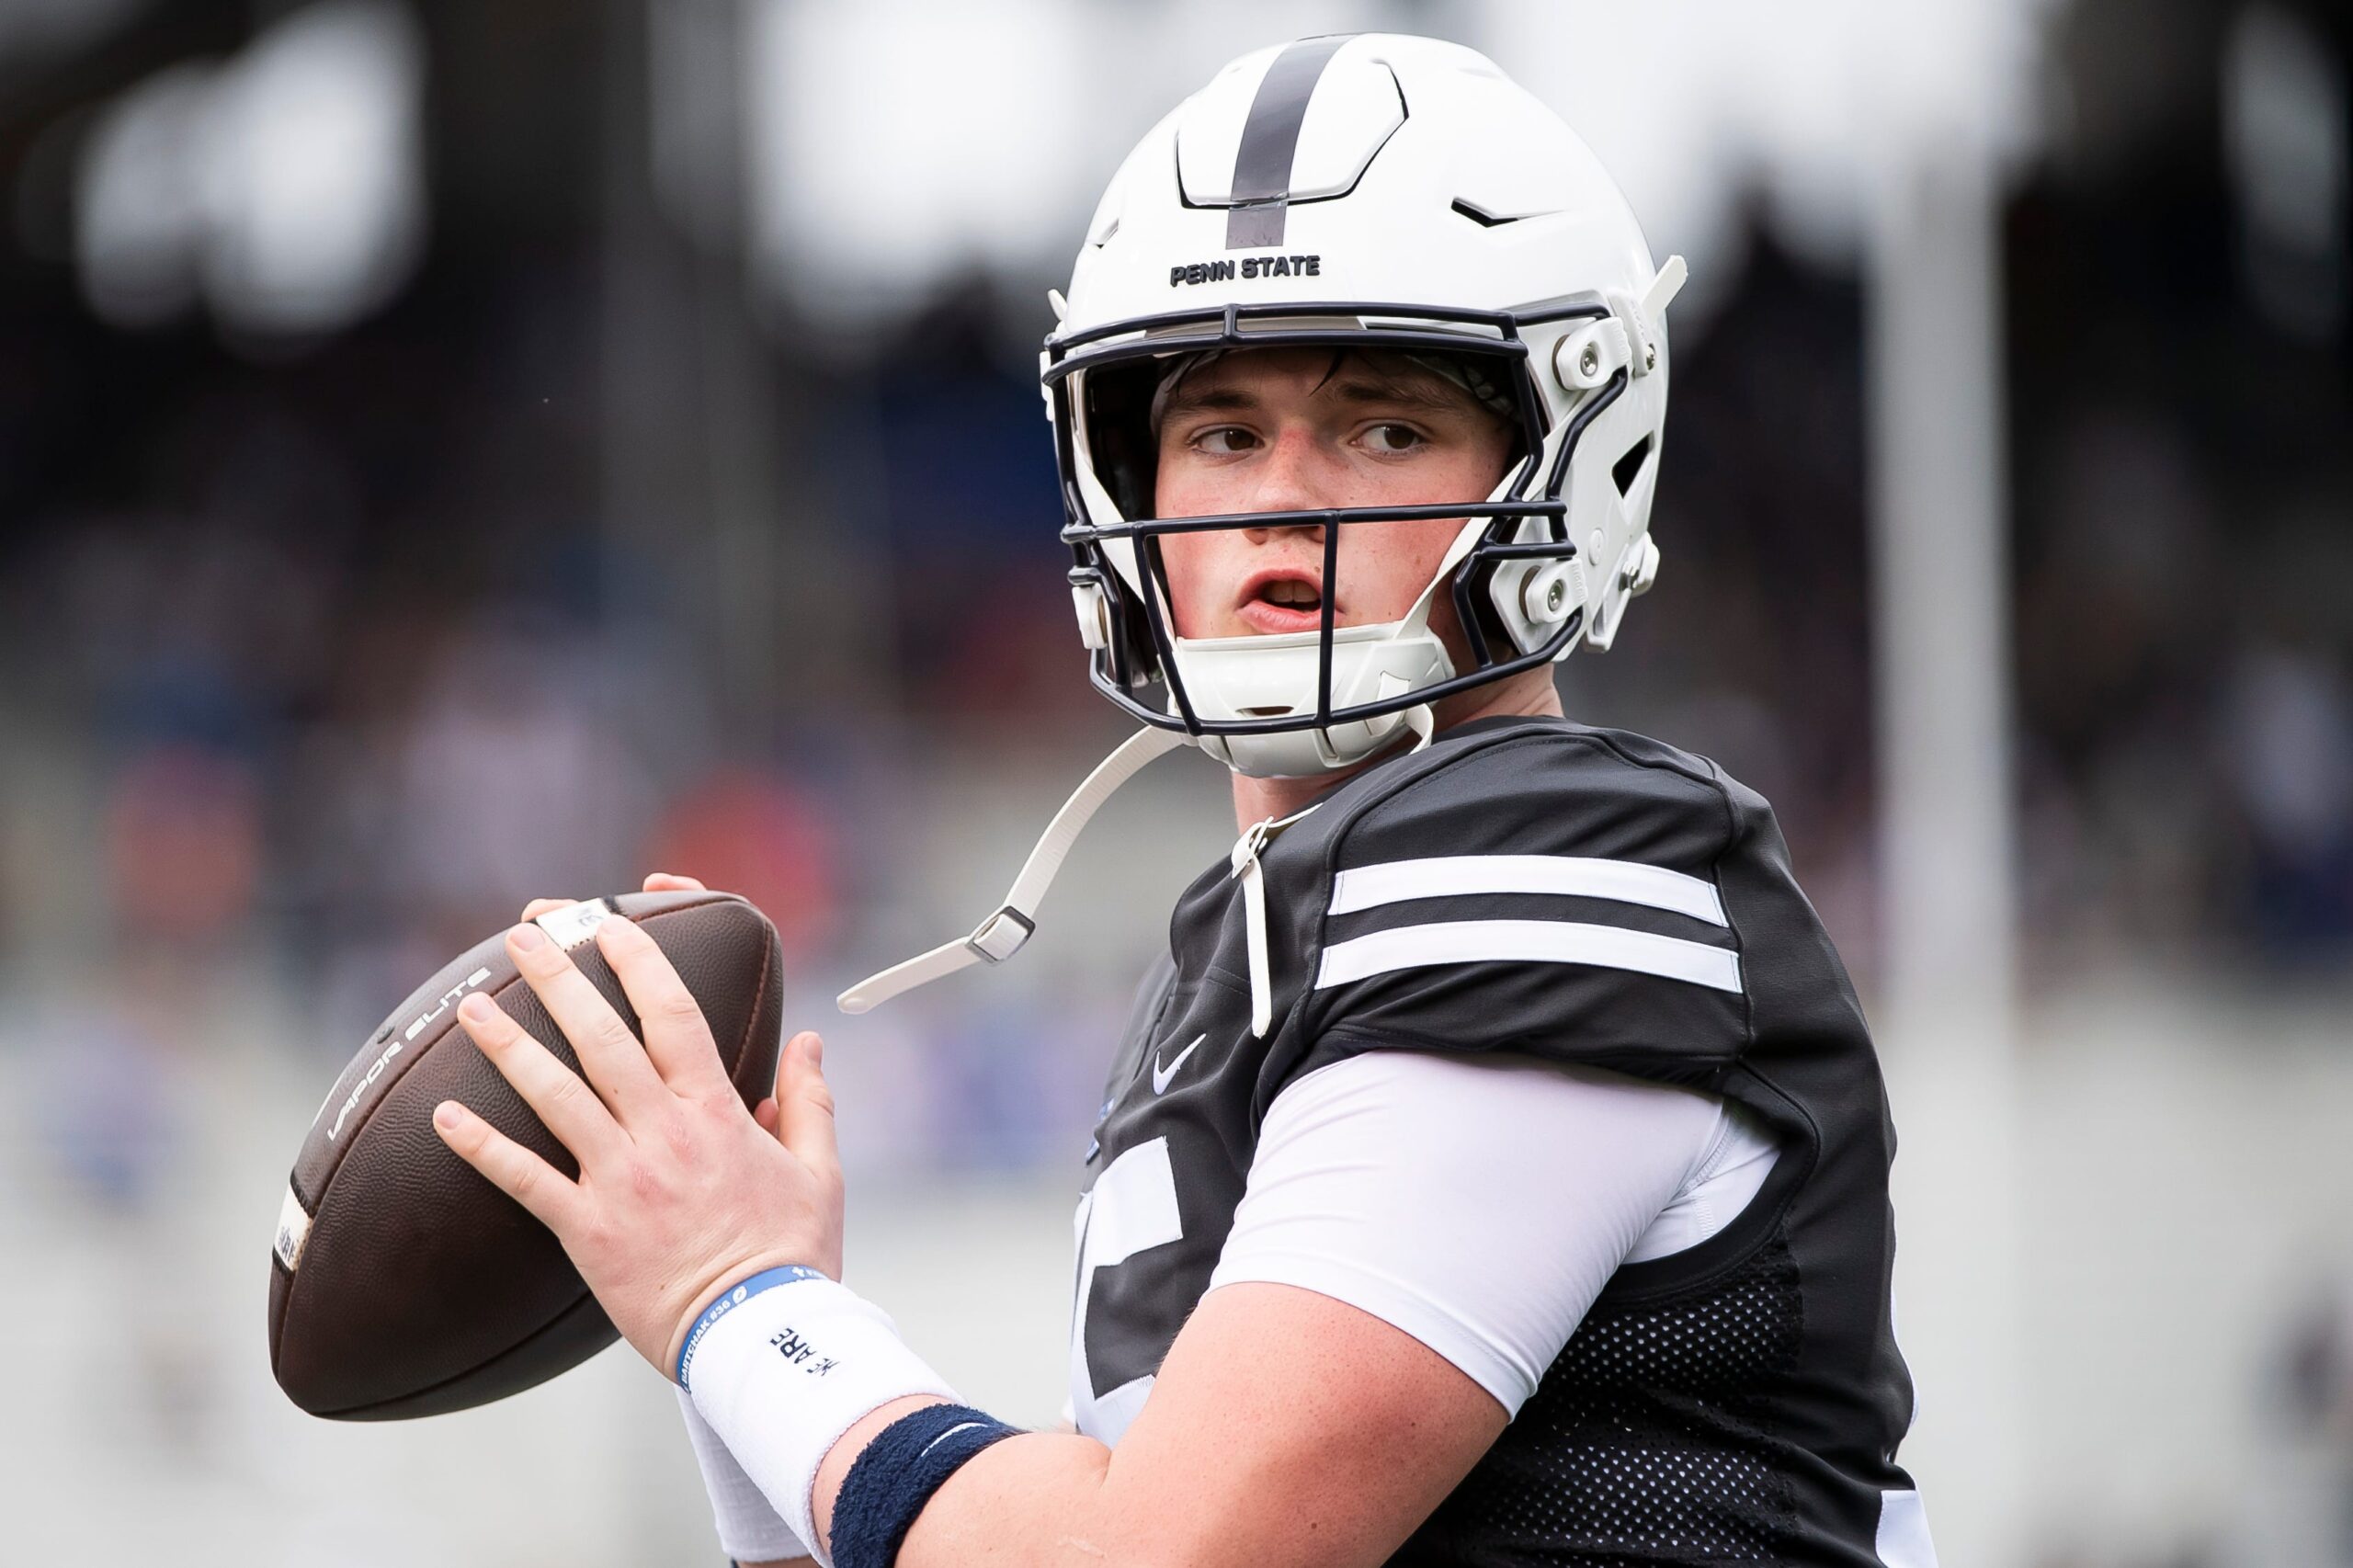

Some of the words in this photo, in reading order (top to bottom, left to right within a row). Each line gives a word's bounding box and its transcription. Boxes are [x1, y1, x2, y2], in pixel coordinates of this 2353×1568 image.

[1170, 260, 1235, 288] PENN
[1241, 255, 1321, 279] STATE
[327, 1040, 404, 1142] VAPOR
[404, 967, 492, 1041] ELITE
[770, 1328, 817, 1364] ARE
